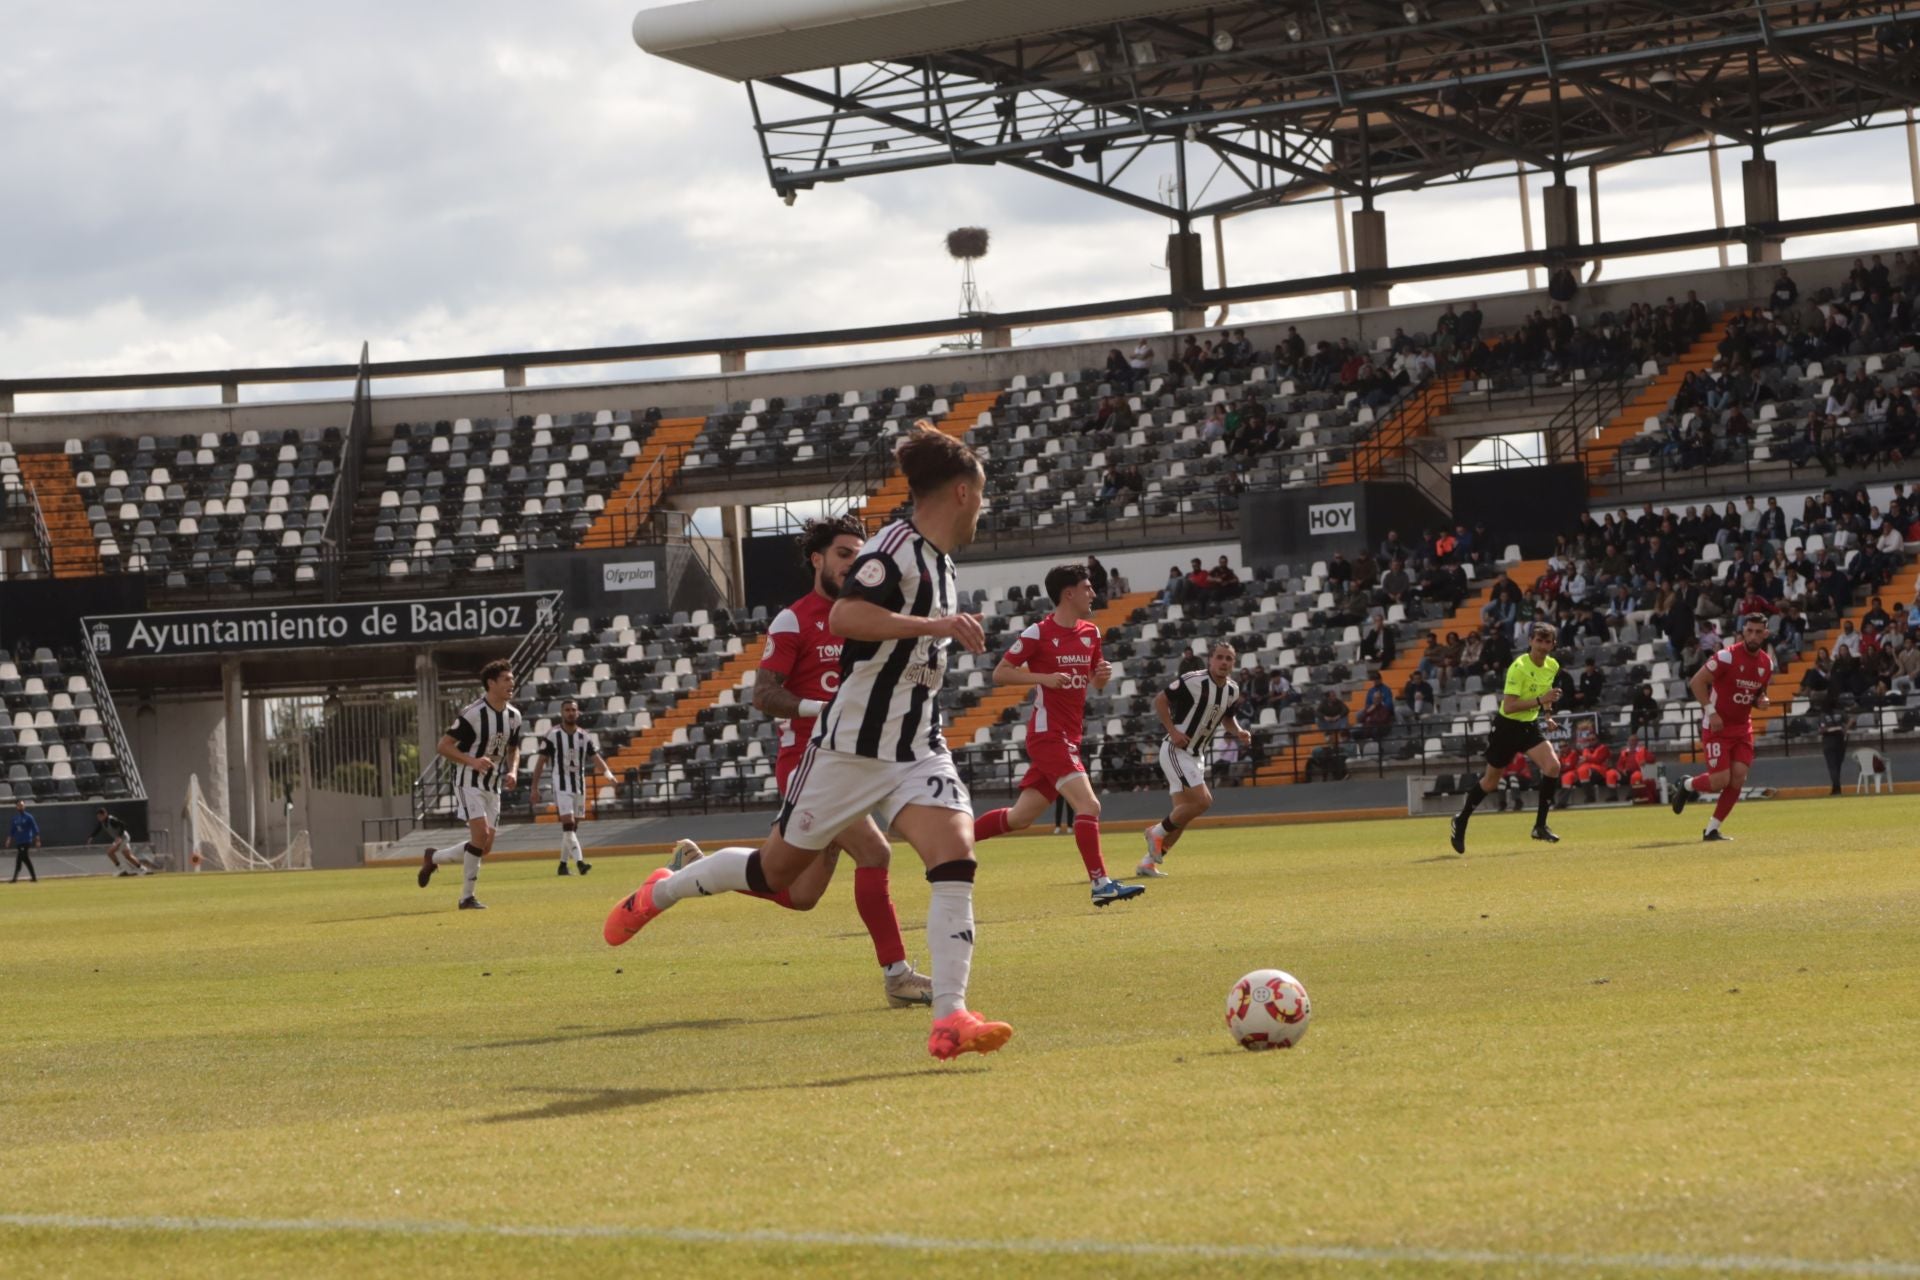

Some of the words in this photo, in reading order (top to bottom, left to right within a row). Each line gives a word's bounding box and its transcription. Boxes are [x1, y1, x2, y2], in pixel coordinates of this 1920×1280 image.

[1311, 507, 1352, 529] HOY
[606, 568, 653, 583] Oferplan
[126, 611, 349, 653] Ayuntamiento
[361, 606, 397, 636] de
[410, 600, 521, 635] Badajoz
[1706, 743, 1721, 758] 18
